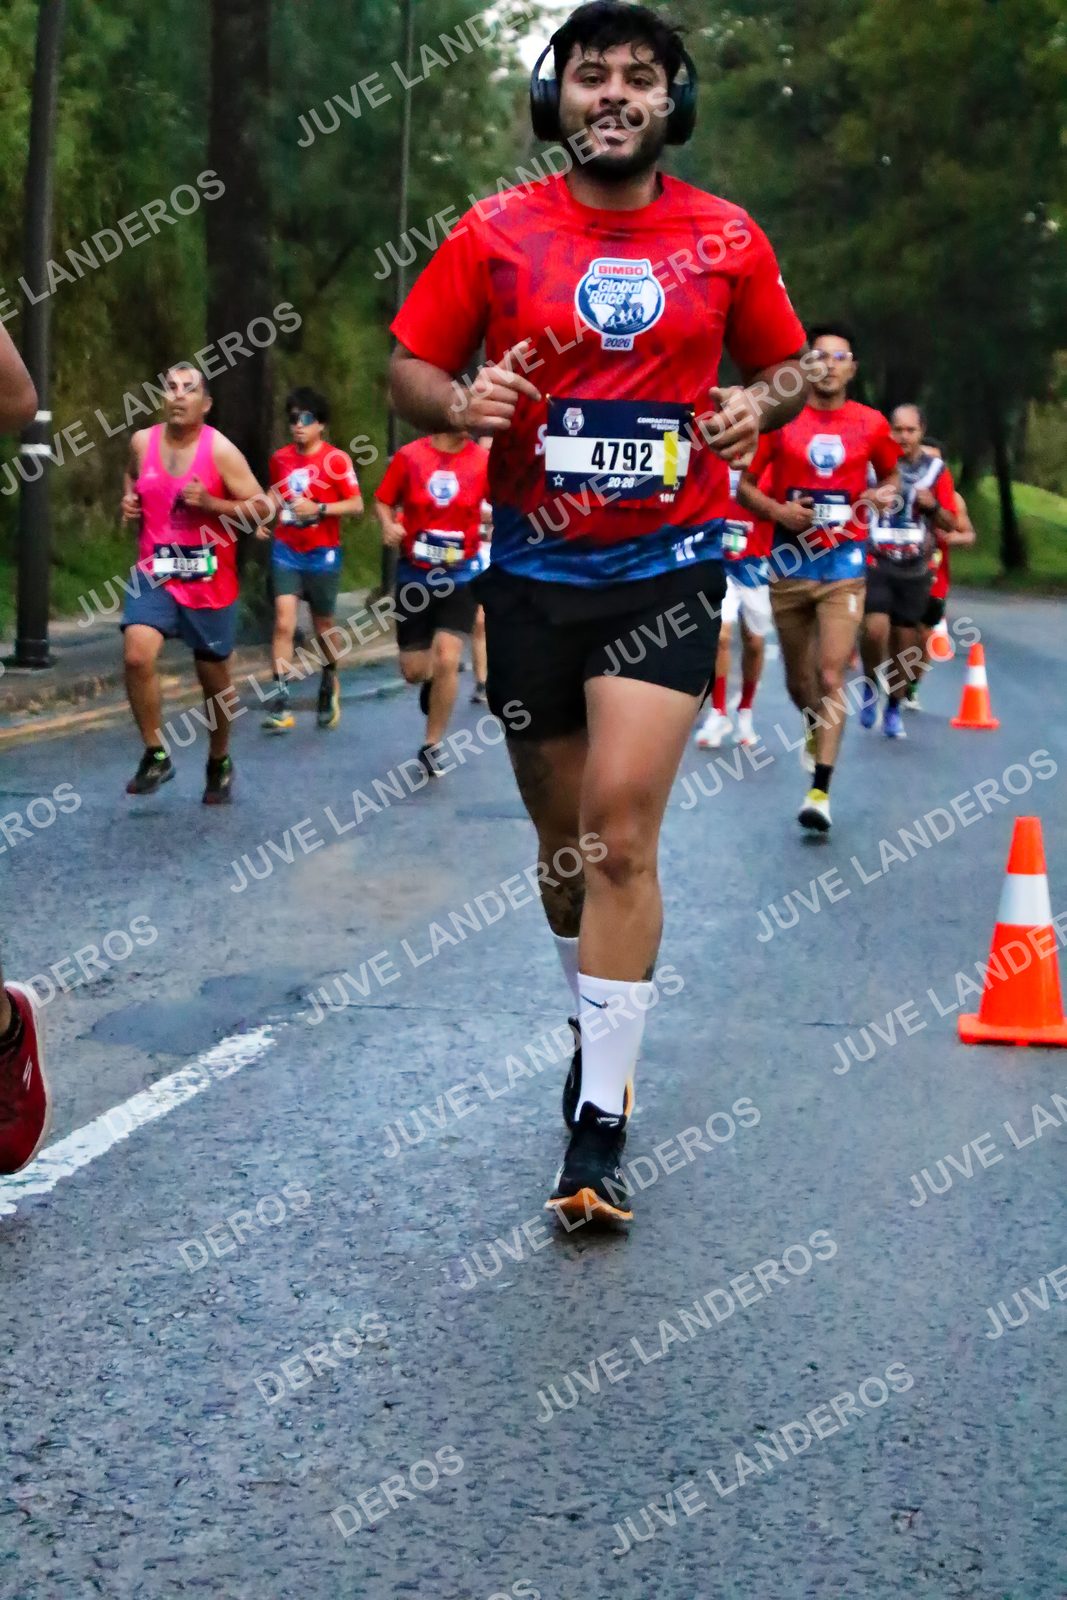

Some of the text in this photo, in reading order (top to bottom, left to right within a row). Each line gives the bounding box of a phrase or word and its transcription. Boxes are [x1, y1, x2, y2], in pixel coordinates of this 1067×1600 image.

[598, 265, 643, 276] BIMBO
[598, 278, 643, 294] Global
[587, 290, 626, 305] Race
[603, 337, 631, 348] 2026
[591, 441, 653, 472] 4792
